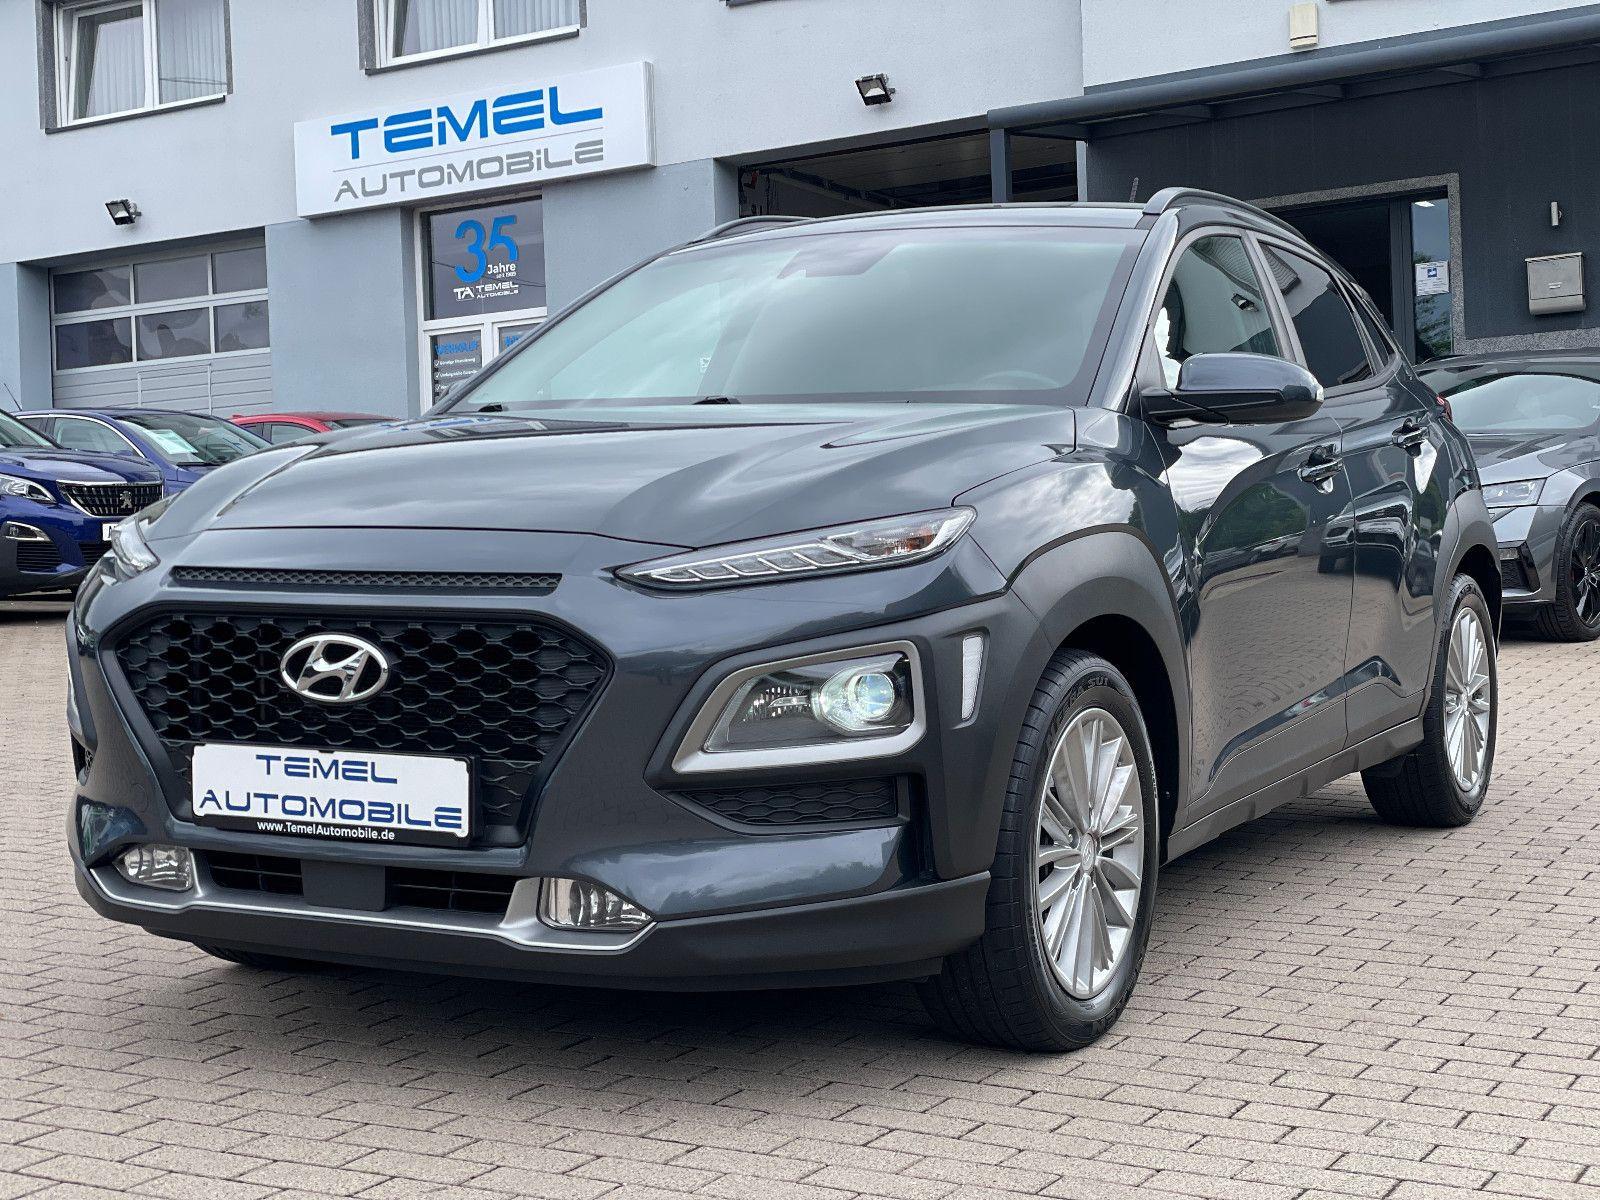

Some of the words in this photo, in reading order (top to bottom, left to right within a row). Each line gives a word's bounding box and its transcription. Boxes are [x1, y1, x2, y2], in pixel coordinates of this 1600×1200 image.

[331, 86, 603, 160] TEMEL
[454, 215, 519, 284] 35
[487, 262, 516, 275] Jahre
[453, 286, 475, 300] TA
[475, 281, 519, 293] TEMEL
[255, 754, 398, 784] TEMEL
[199, 789, 462, 829] AUTOMOBILE
[256, 820, 396, 841] www.TemelAutomobile.de
